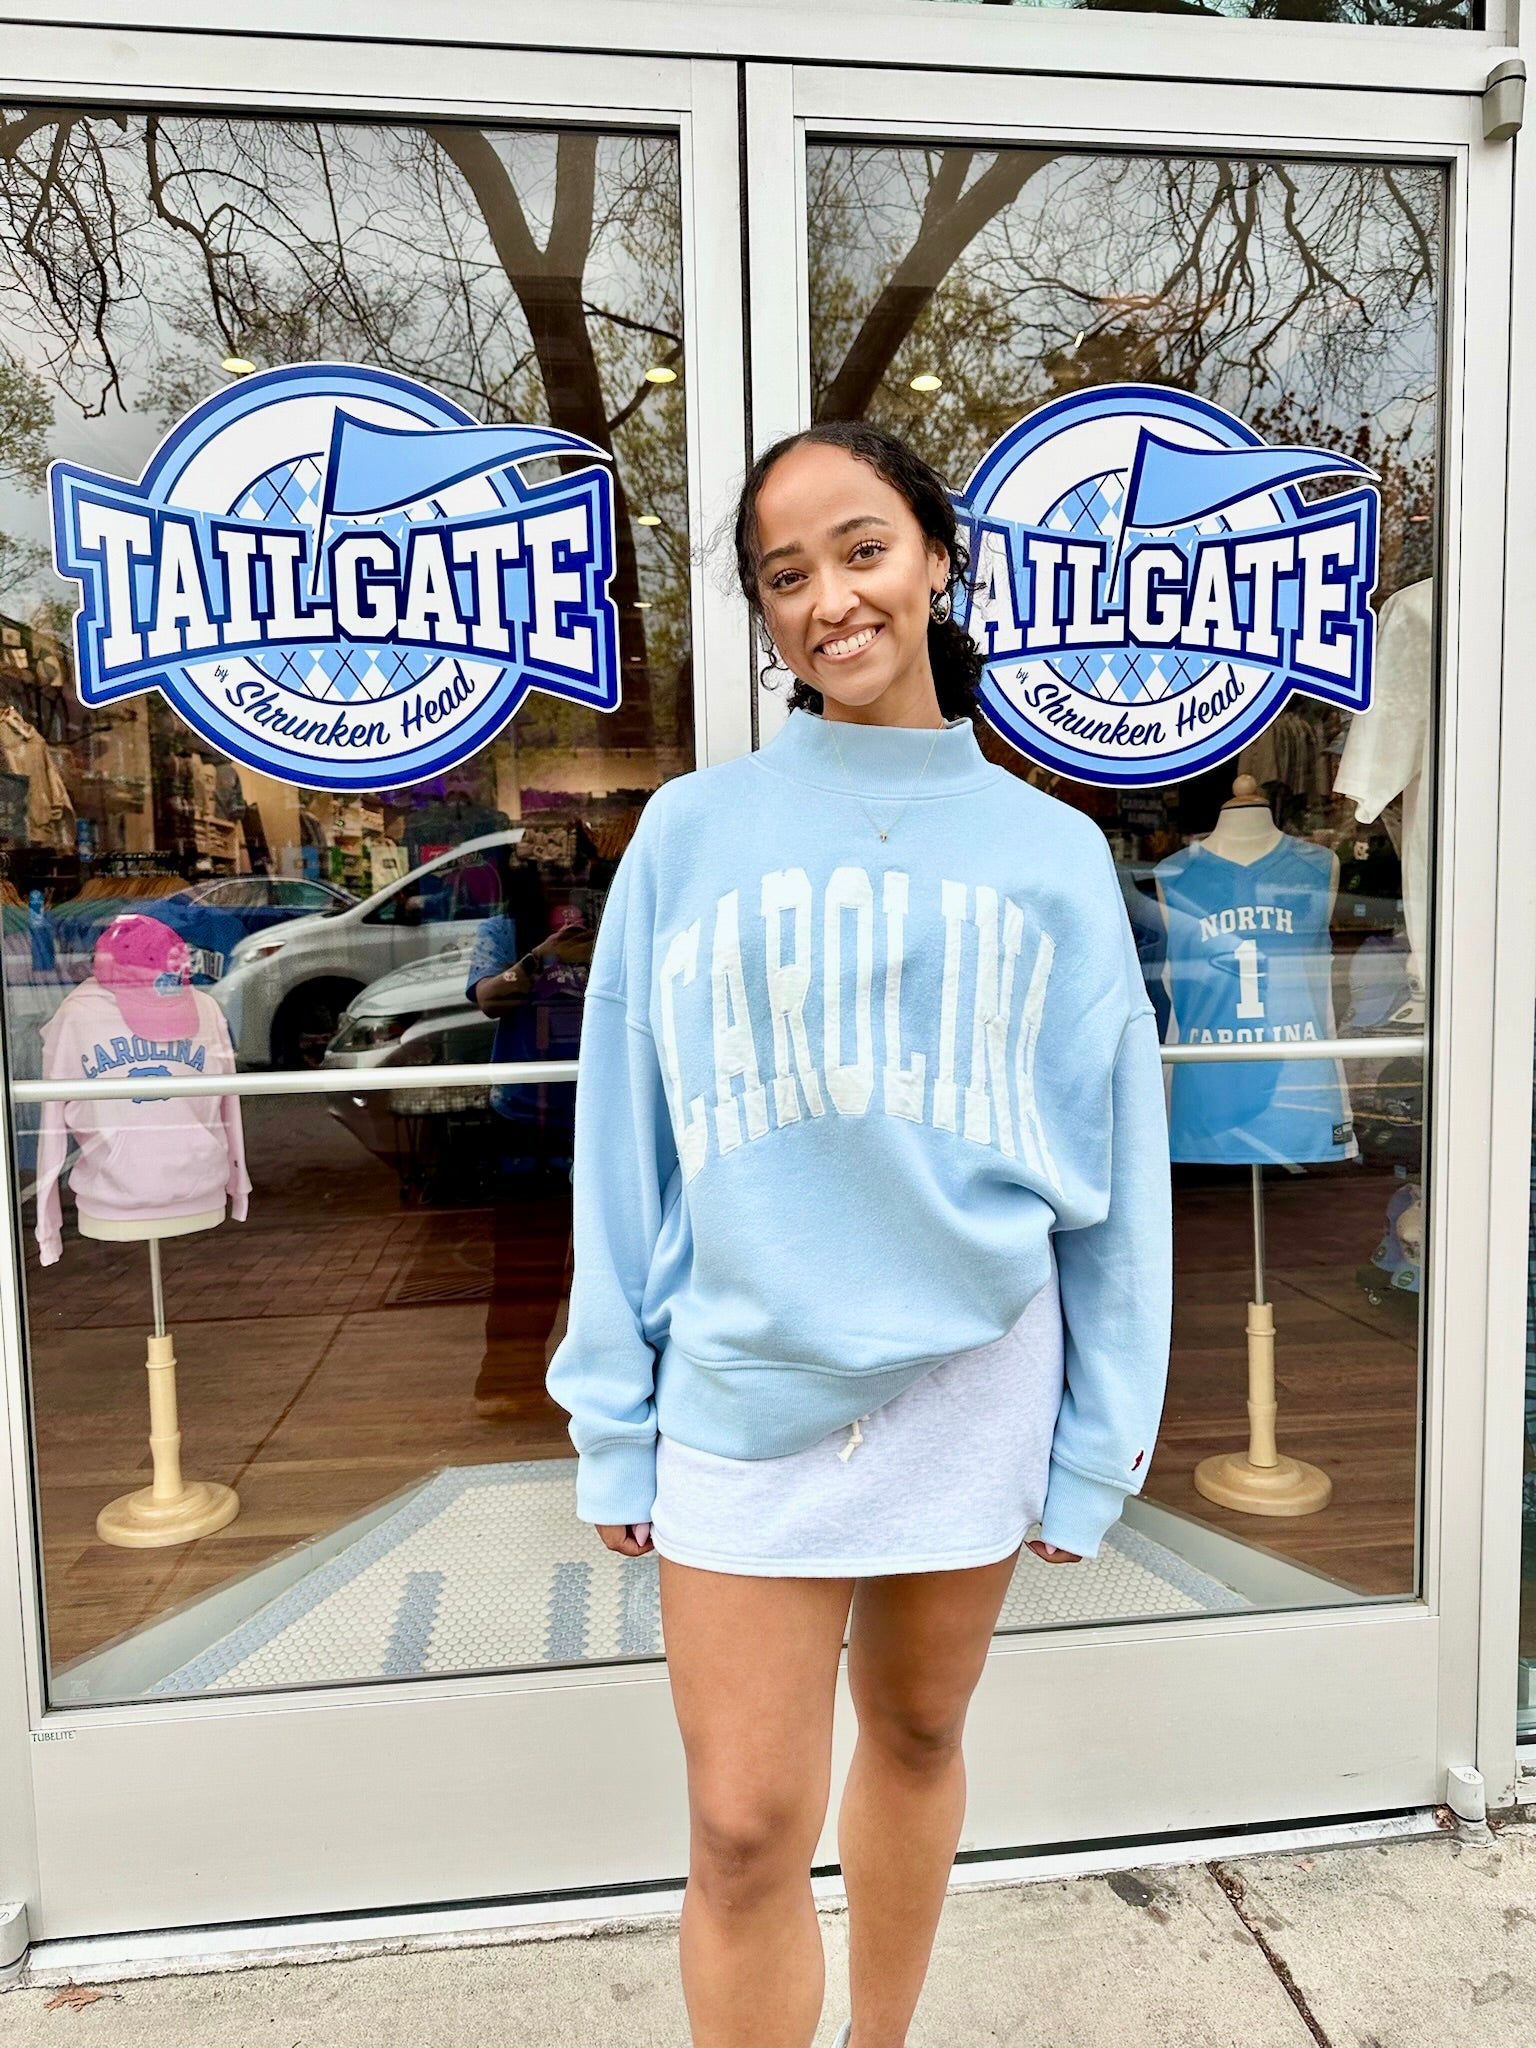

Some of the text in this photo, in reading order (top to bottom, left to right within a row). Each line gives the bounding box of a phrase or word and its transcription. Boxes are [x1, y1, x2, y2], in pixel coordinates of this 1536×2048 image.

[75, 498, 597, 677] TAILGATE
[954, 516, 1358, 681] AILGATE
[214, 658, 476, 748] by Shrunken Head
[1015, 663, 1245, 746] by Shrunken Head
[1199, 905, 1294, 943] NORTH
[1233, 939, 1265, 1019] 1
[80, 1034, 206, 1079] CAROLINA
[659, 866, 1064, 1199] CAROLINA
